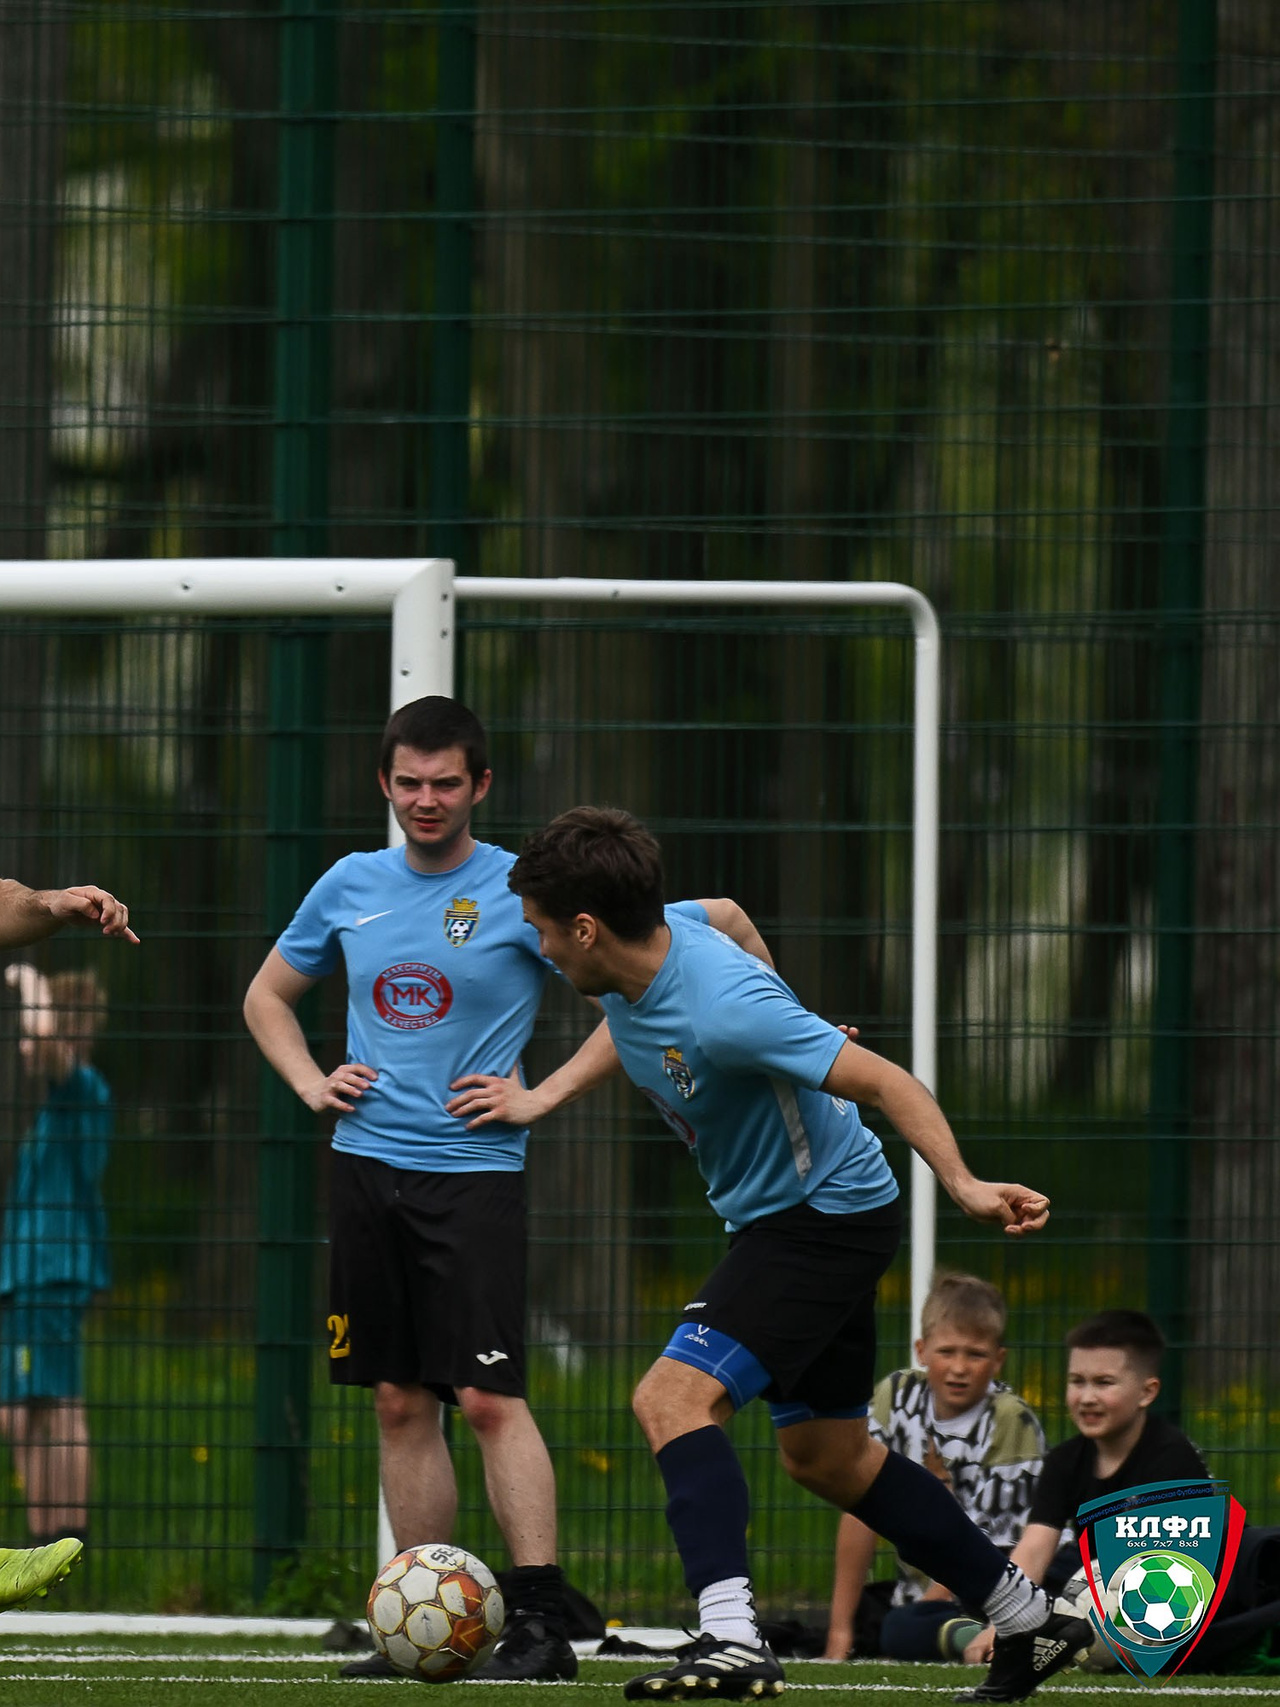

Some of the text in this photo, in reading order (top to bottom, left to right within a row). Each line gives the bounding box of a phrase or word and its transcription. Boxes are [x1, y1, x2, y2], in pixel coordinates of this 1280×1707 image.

[381, 964, 442, 980] МАКСИМУМ
[384, 1014, 439, 1029] КАЧЕСТВА
[1033, 1639, 1068, 1672] adidas
